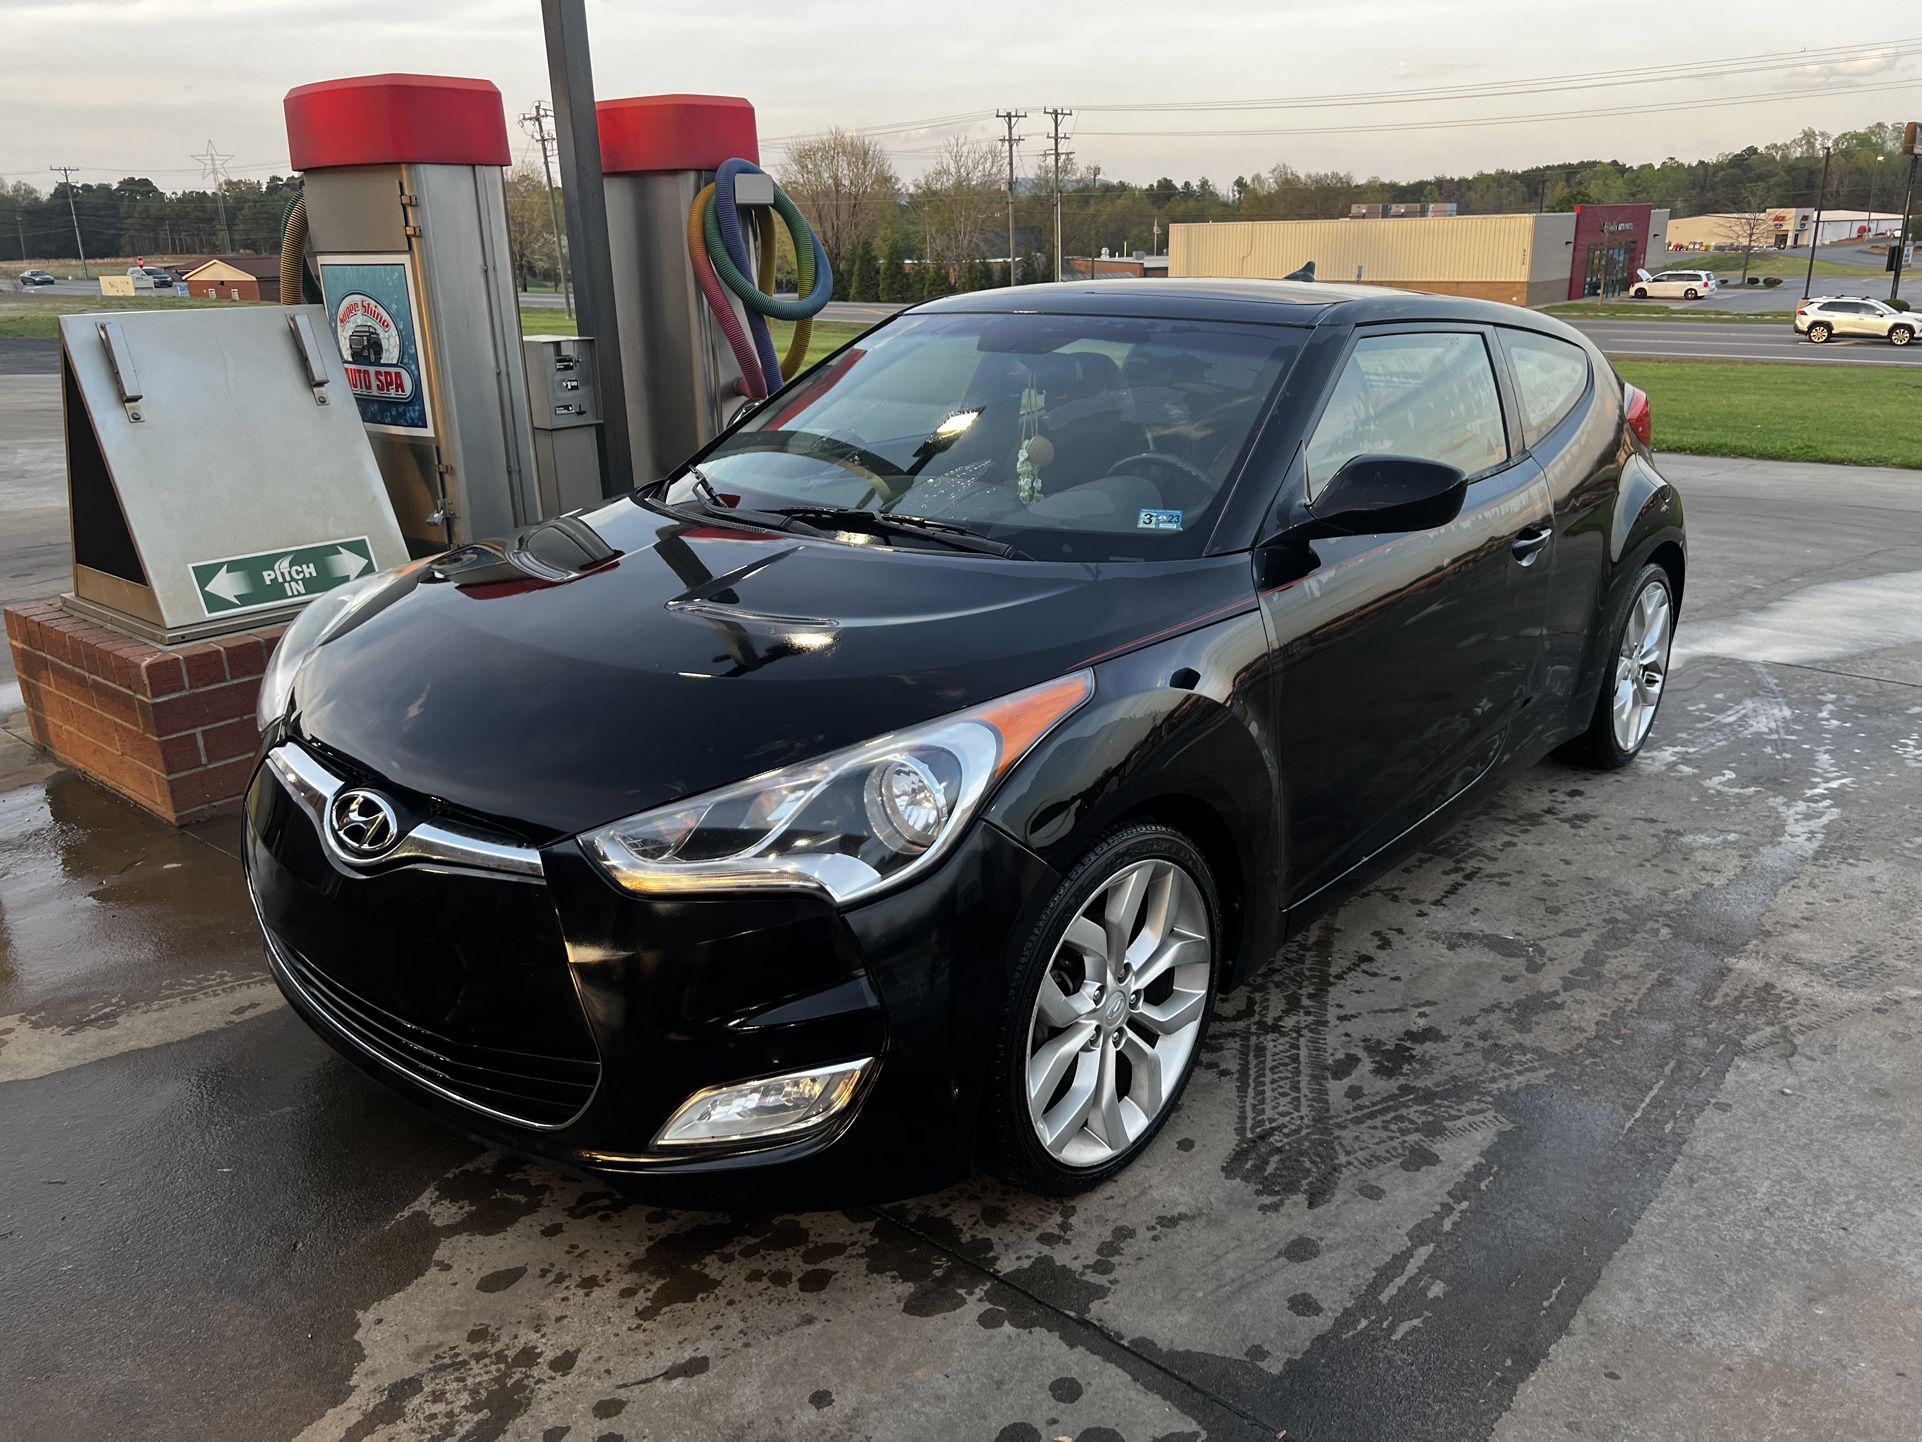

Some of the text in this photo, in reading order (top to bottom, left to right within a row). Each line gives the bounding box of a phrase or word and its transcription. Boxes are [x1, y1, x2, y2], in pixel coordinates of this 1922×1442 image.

[339, 300, 391, 331] Super Shine
[375, 370, 406, 394] SPA
[1143, 513, 1180, 525] 3 23
[262, 557, 317, 585] PITCH
[284, 579, 306, 597] IN
